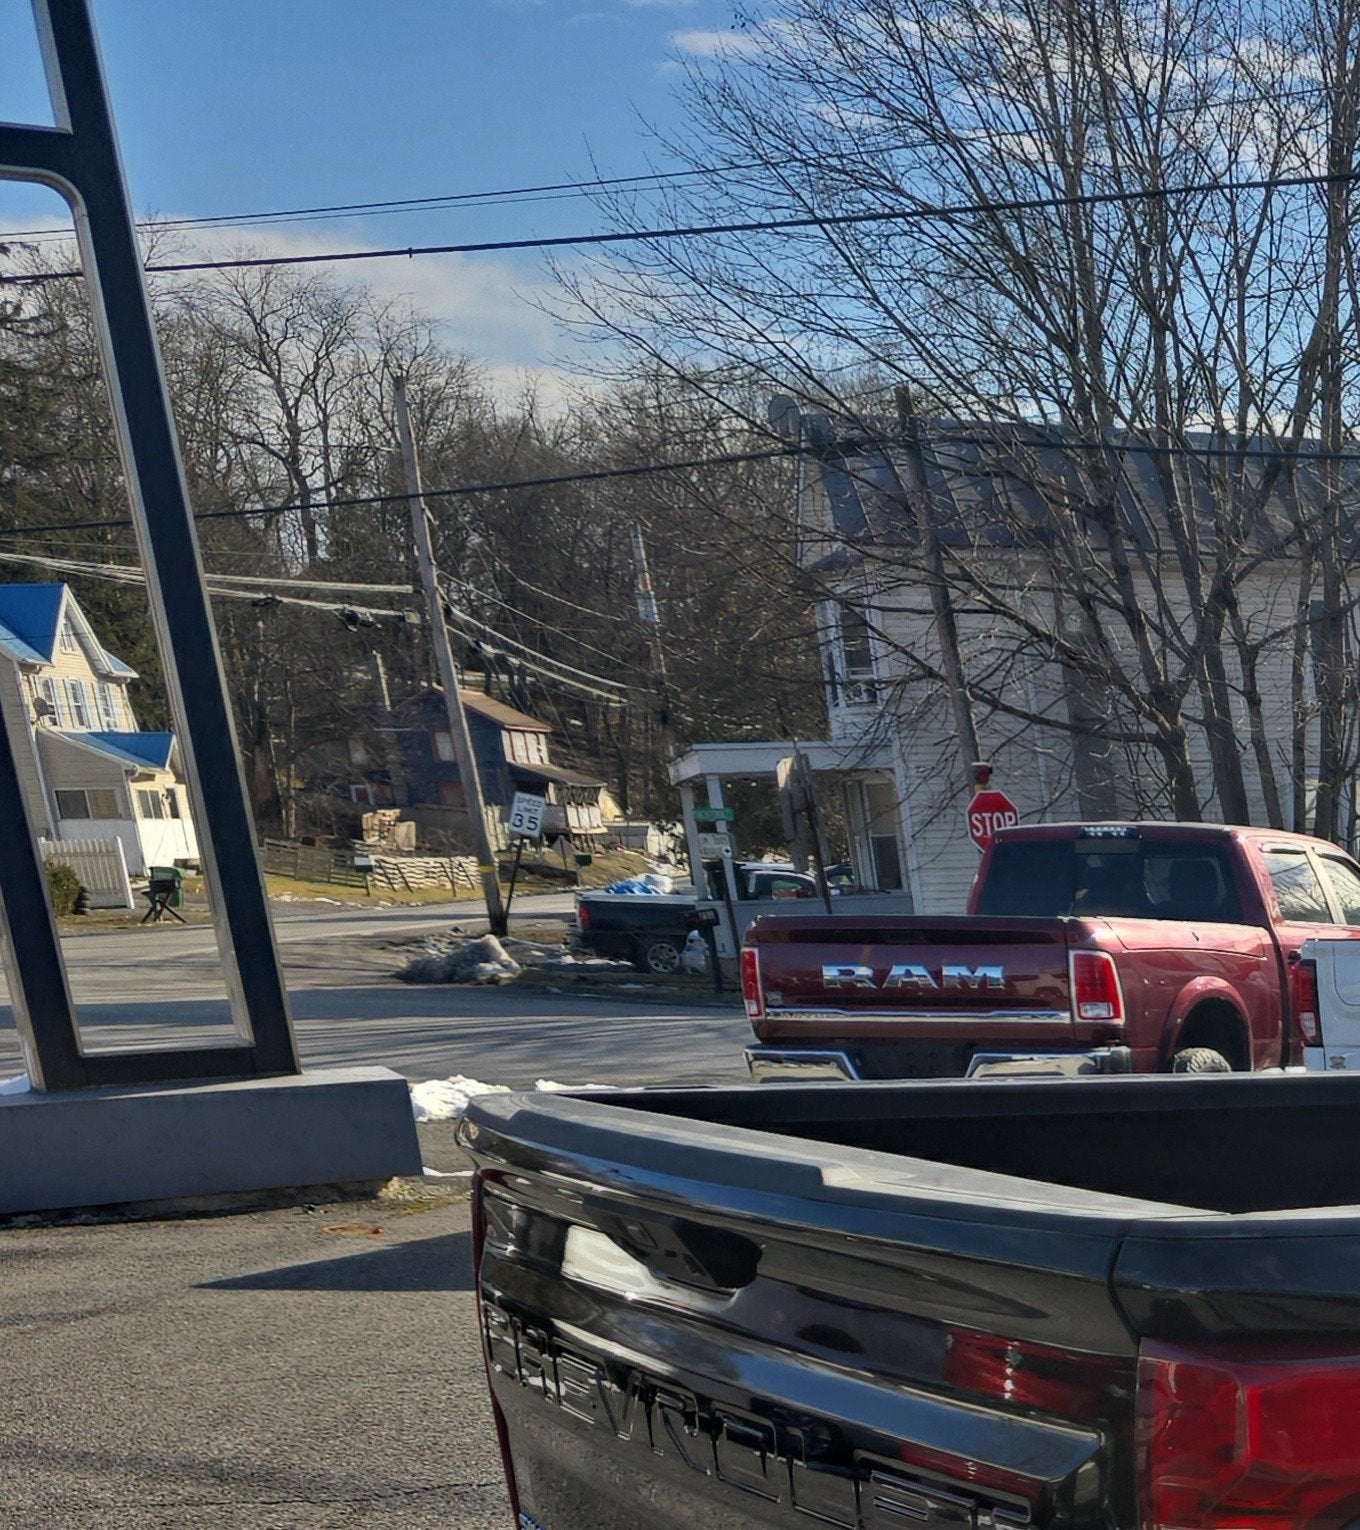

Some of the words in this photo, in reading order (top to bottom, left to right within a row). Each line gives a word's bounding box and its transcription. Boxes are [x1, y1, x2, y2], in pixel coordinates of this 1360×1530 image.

[512, 813, 538, 830] 35
[971, 811, 1017, 836] STOP
[822, 963, 1005, 991] RAM
